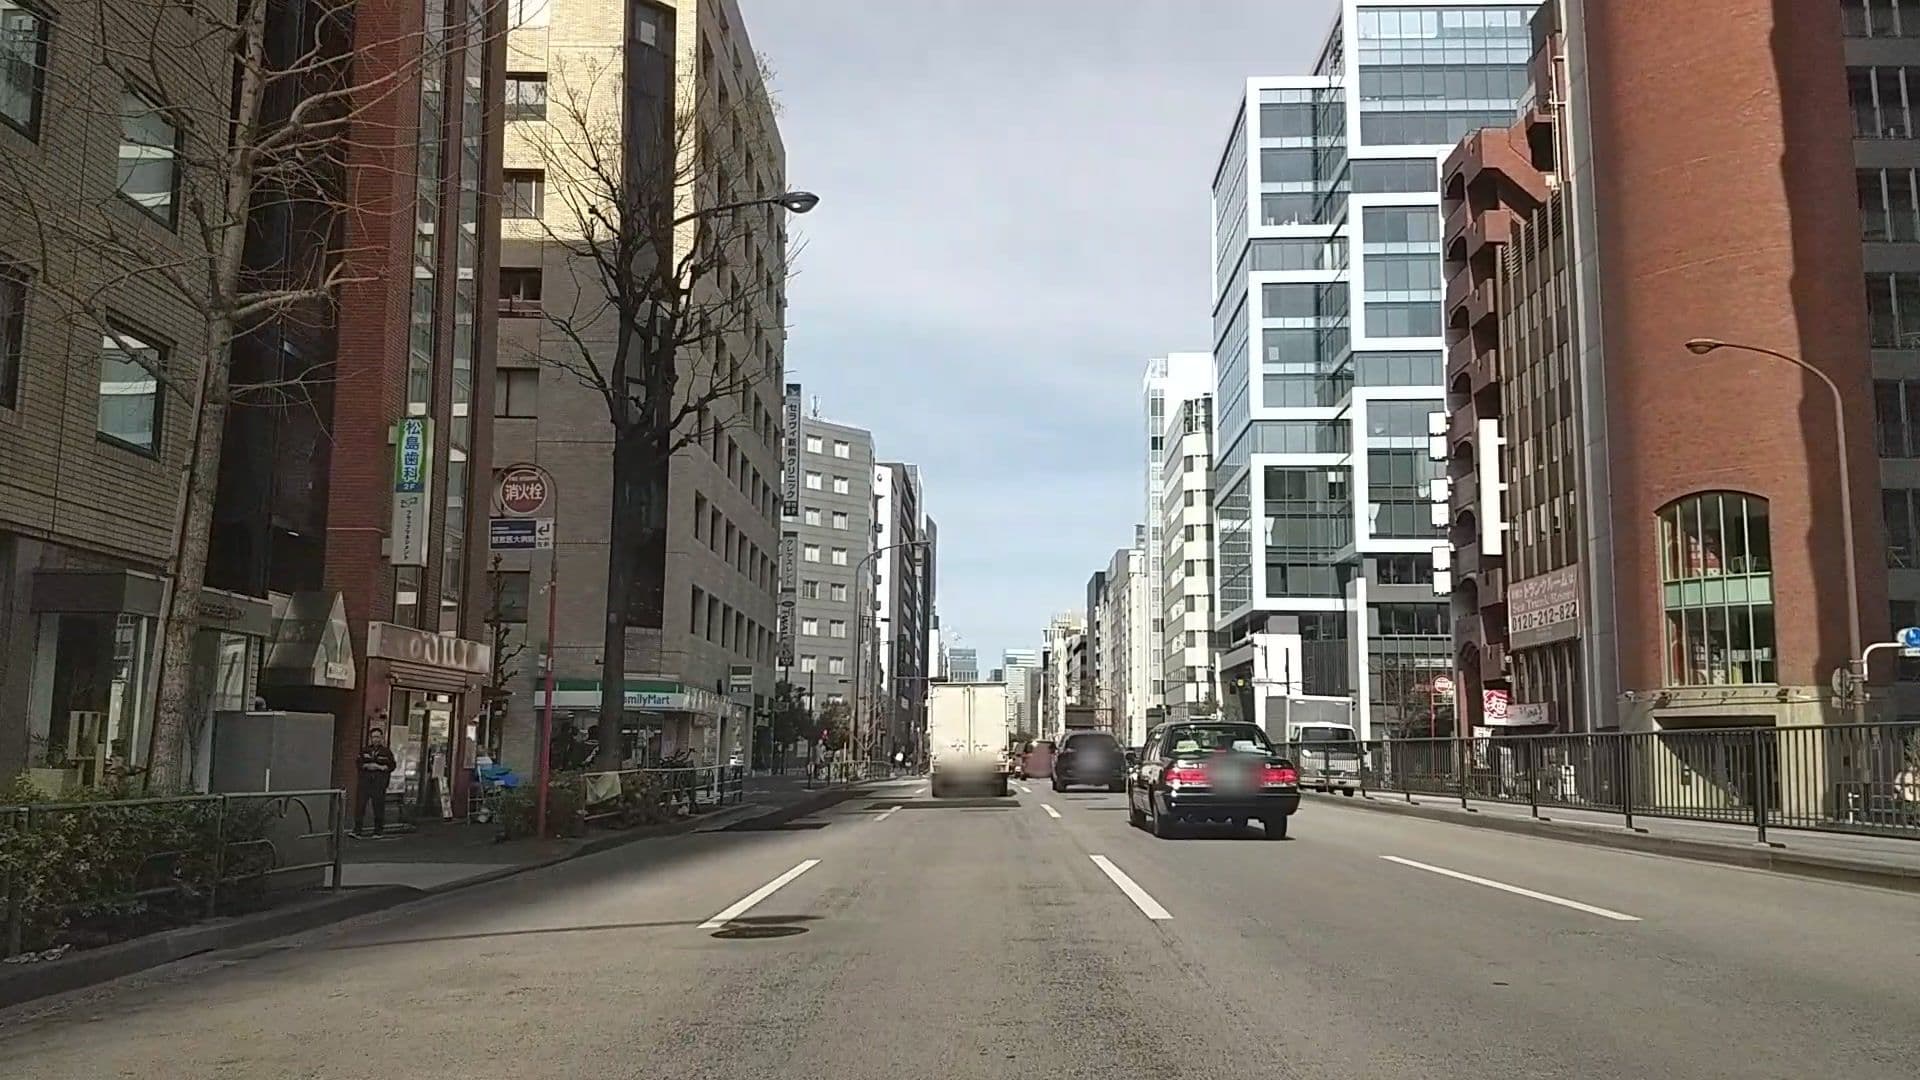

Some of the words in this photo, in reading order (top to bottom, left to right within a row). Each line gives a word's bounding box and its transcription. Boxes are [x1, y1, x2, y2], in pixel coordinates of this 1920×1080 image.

[403, 420, 422, 482] 松島歯科
[505, 483, 543, 501] 消火栓
[1512, 602, 1577, 631] 0120-212-822
